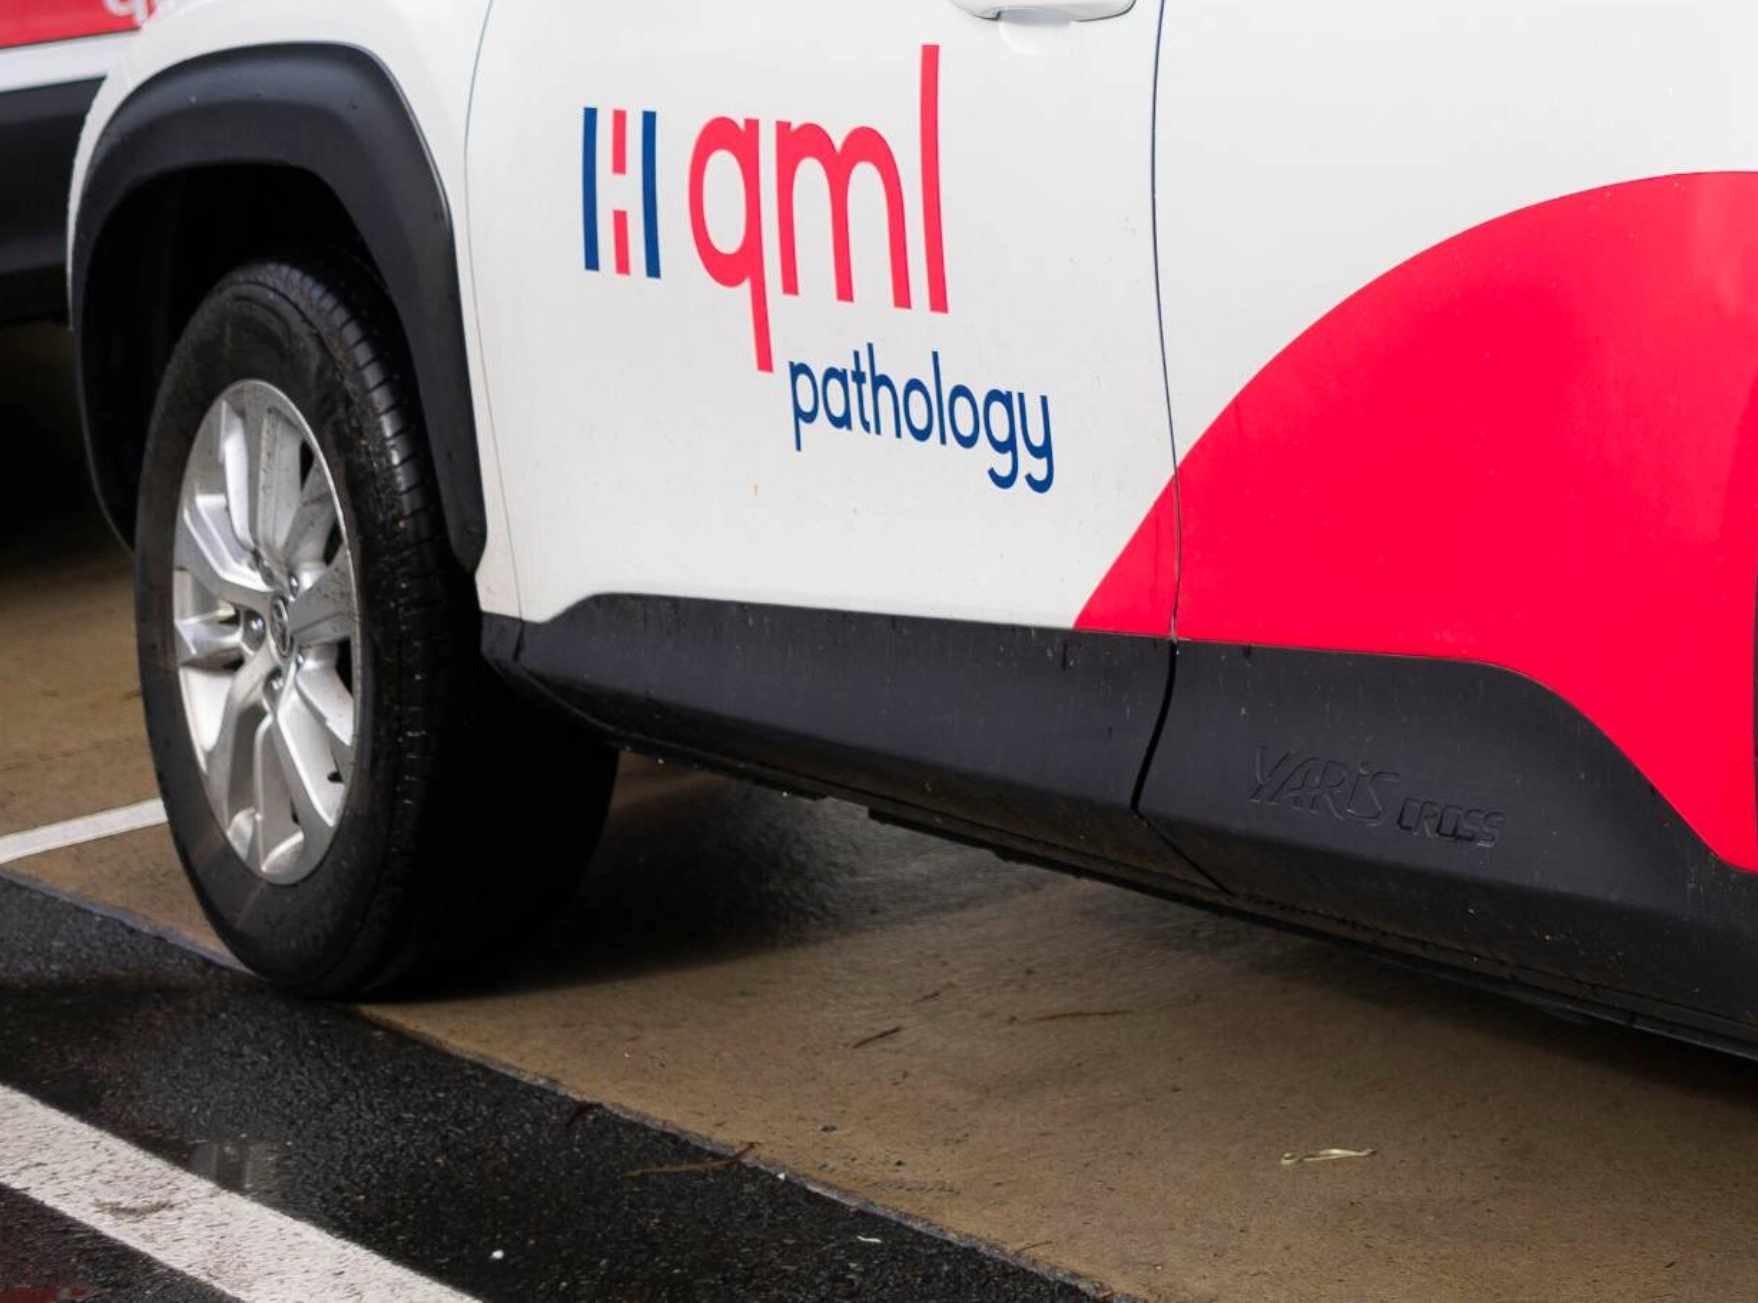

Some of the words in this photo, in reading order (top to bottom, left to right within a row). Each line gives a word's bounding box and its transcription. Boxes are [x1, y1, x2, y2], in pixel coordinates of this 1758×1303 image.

[687, 44, 949, 373] qml
[788, 343, 1055, 494] pathology
[1396, 796, 1505, 849] CROSS
